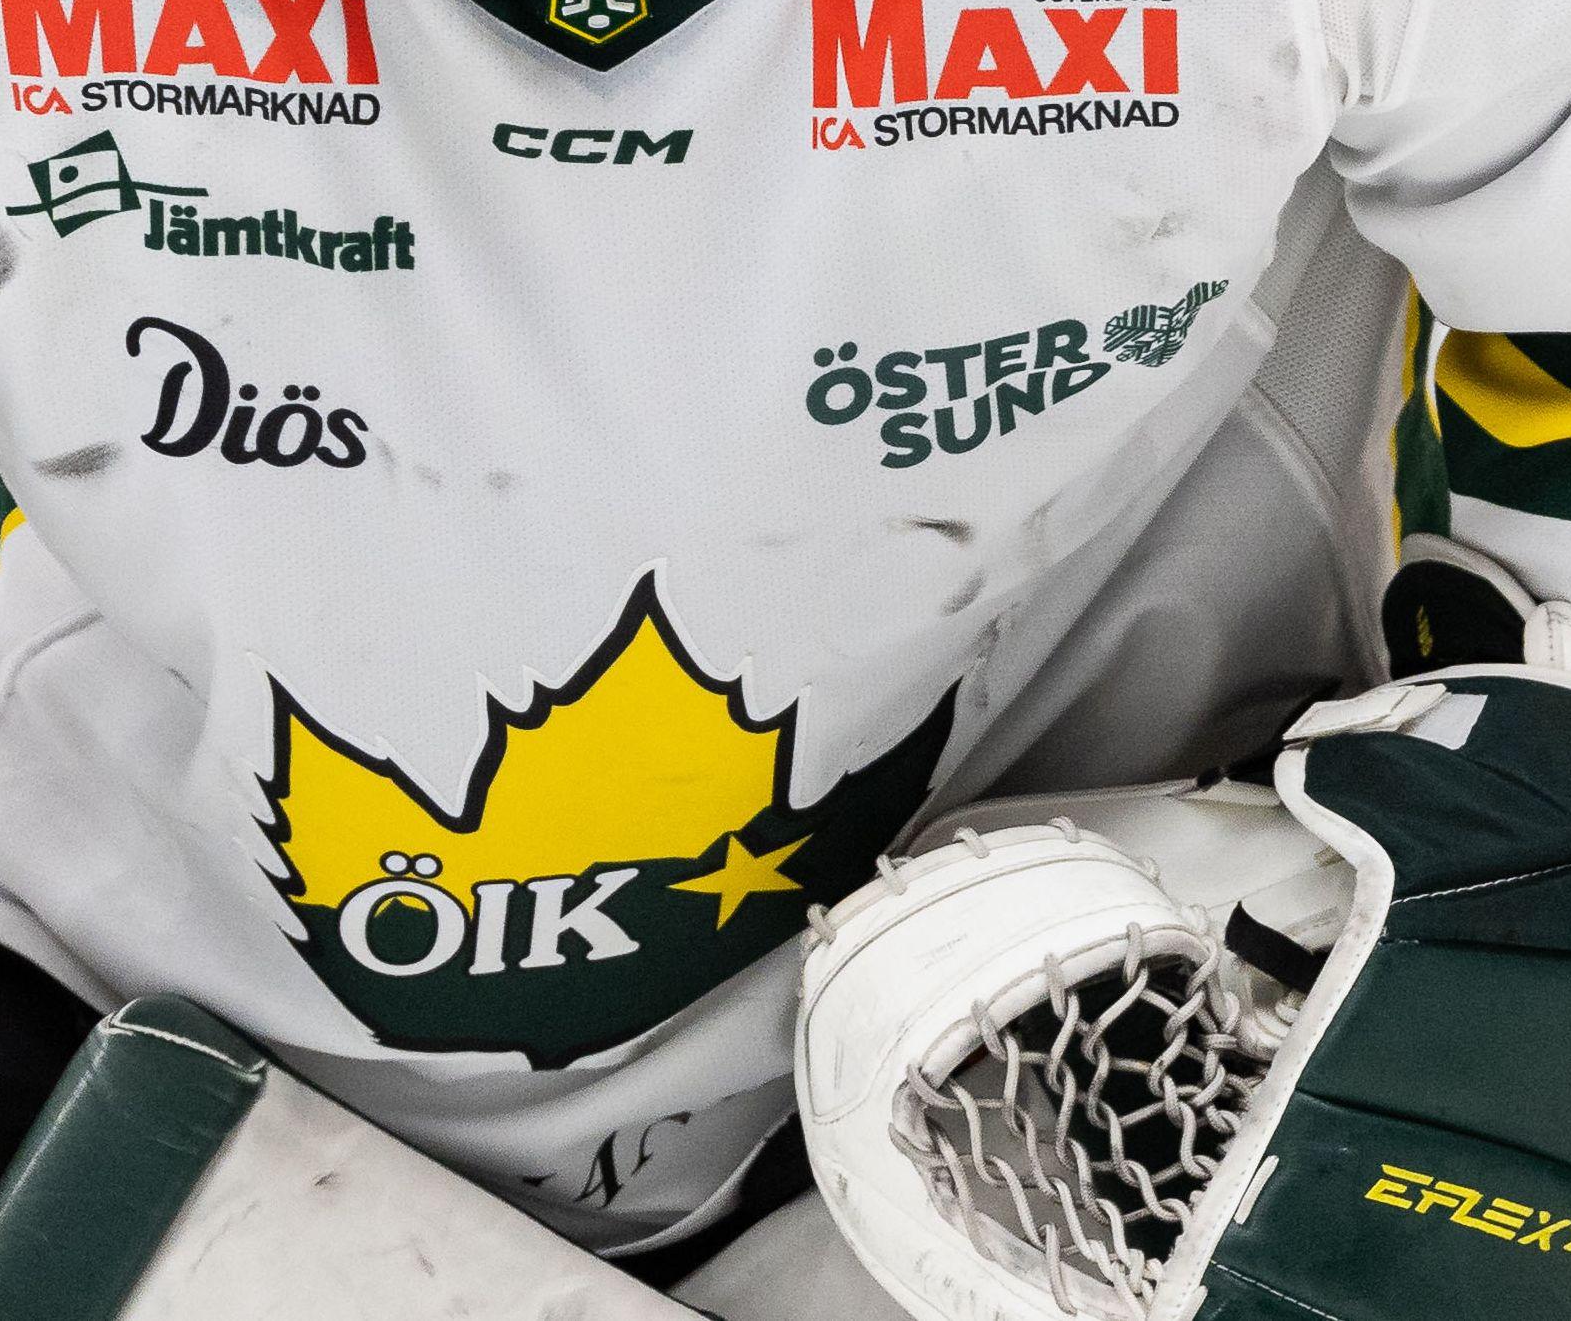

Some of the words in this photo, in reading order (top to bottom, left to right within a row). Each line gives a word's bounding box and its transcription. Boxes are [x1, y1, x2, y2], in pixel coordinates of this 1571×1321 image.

[11, 82, 73, 115] ICA
[81, 79, 381, 126] STORMARKNAD
[492, 122, 694, 165] CCM
[812, 116, 867, 151] ICA
[873, 99, 1180, 147] STORMARKNAD
[144, 198, 416, 273] Jämtkraft
[126, 316, 369, 469] Diös
[806, 319, 1091, 426] ÖSTER
[880, 362, 1112, 470] SUND
[338, 849, 640, 977] ÖIK
